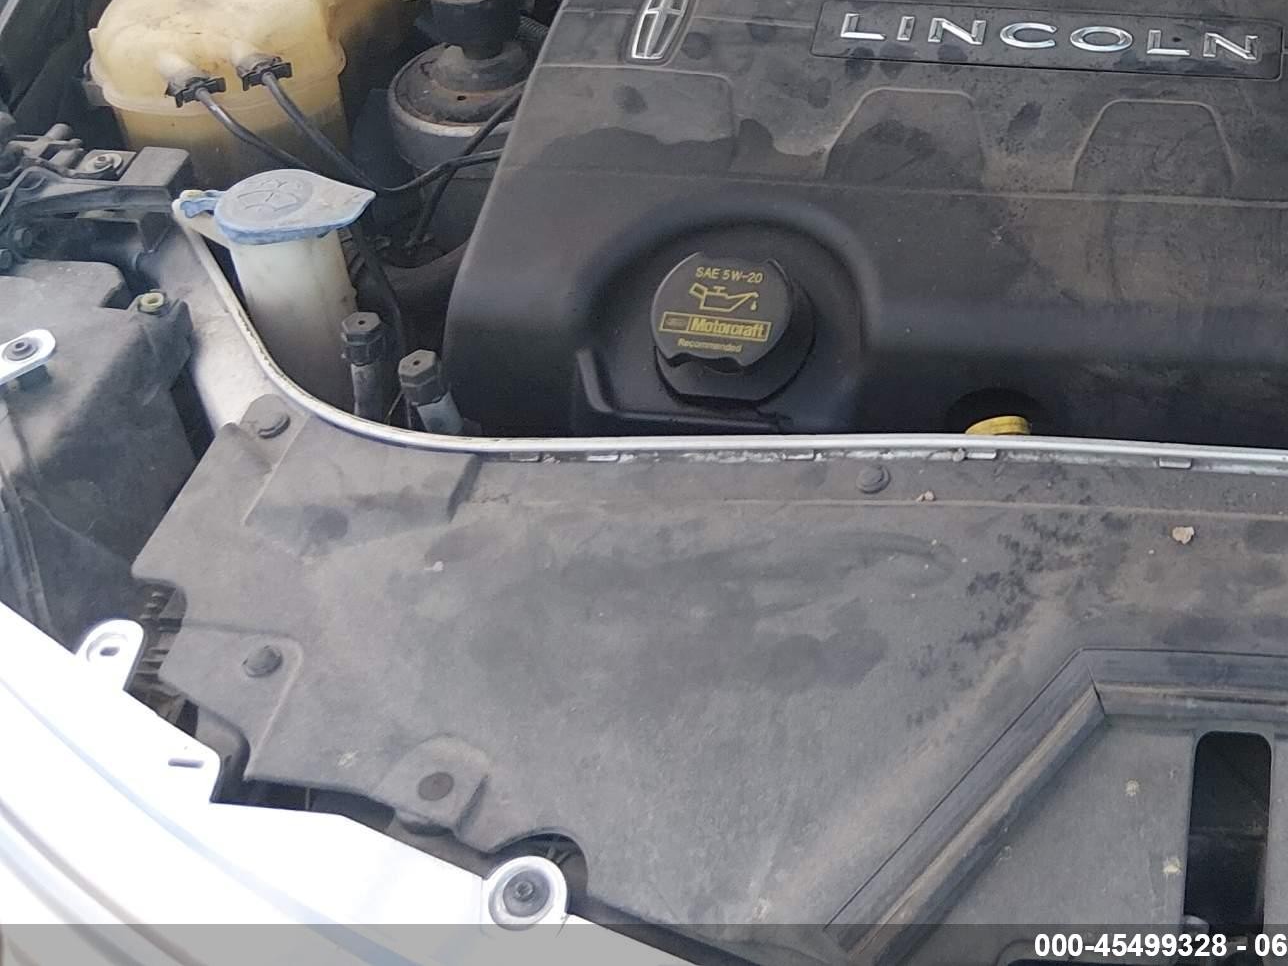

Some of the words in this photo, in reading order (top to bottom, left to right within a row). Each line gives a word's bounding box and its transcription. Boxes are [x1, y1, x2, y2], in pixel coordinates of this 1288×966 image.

[840, 13, 1258, 61] LINCOLN
[695, 266, 721, 279] SAE
[722, 269, 764, 283] 5W-20
[690, 317, 764, 338] Motorcraft
[677, 338, 743, 352] Recommended
